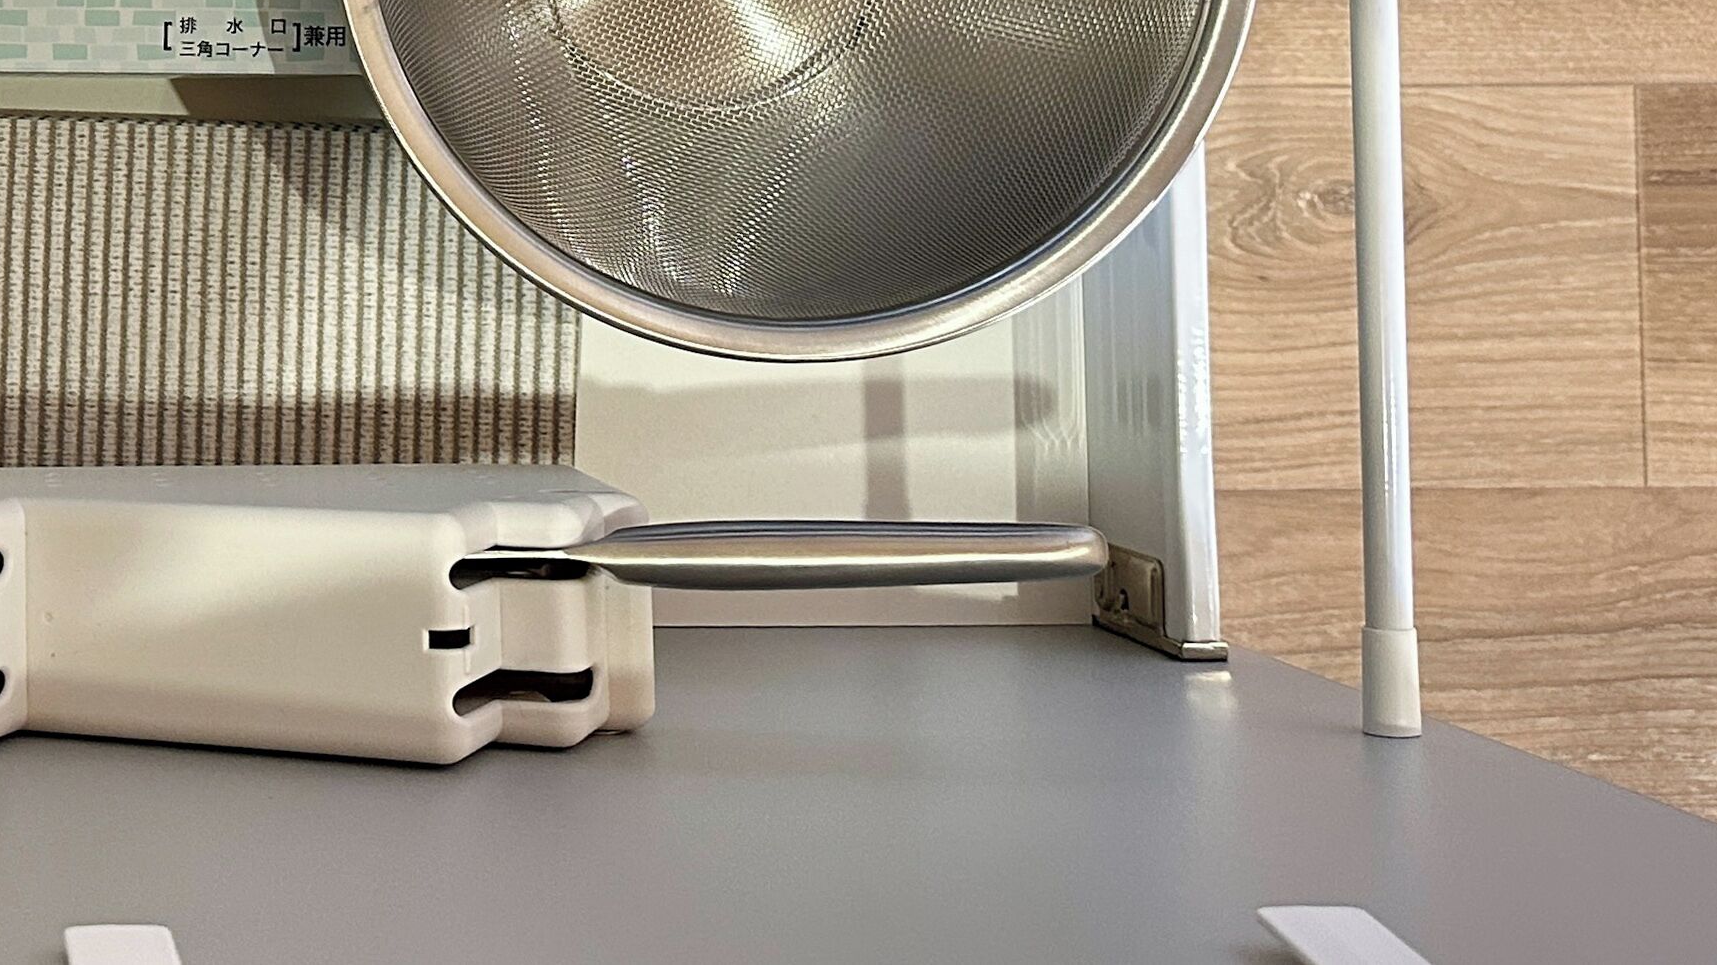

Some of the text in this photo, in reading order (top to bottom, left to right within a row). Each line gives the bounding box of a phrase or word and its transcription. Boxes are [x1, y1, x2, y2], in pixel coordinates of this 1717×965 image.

[179, 40, 284, 58] 三角コーナー
